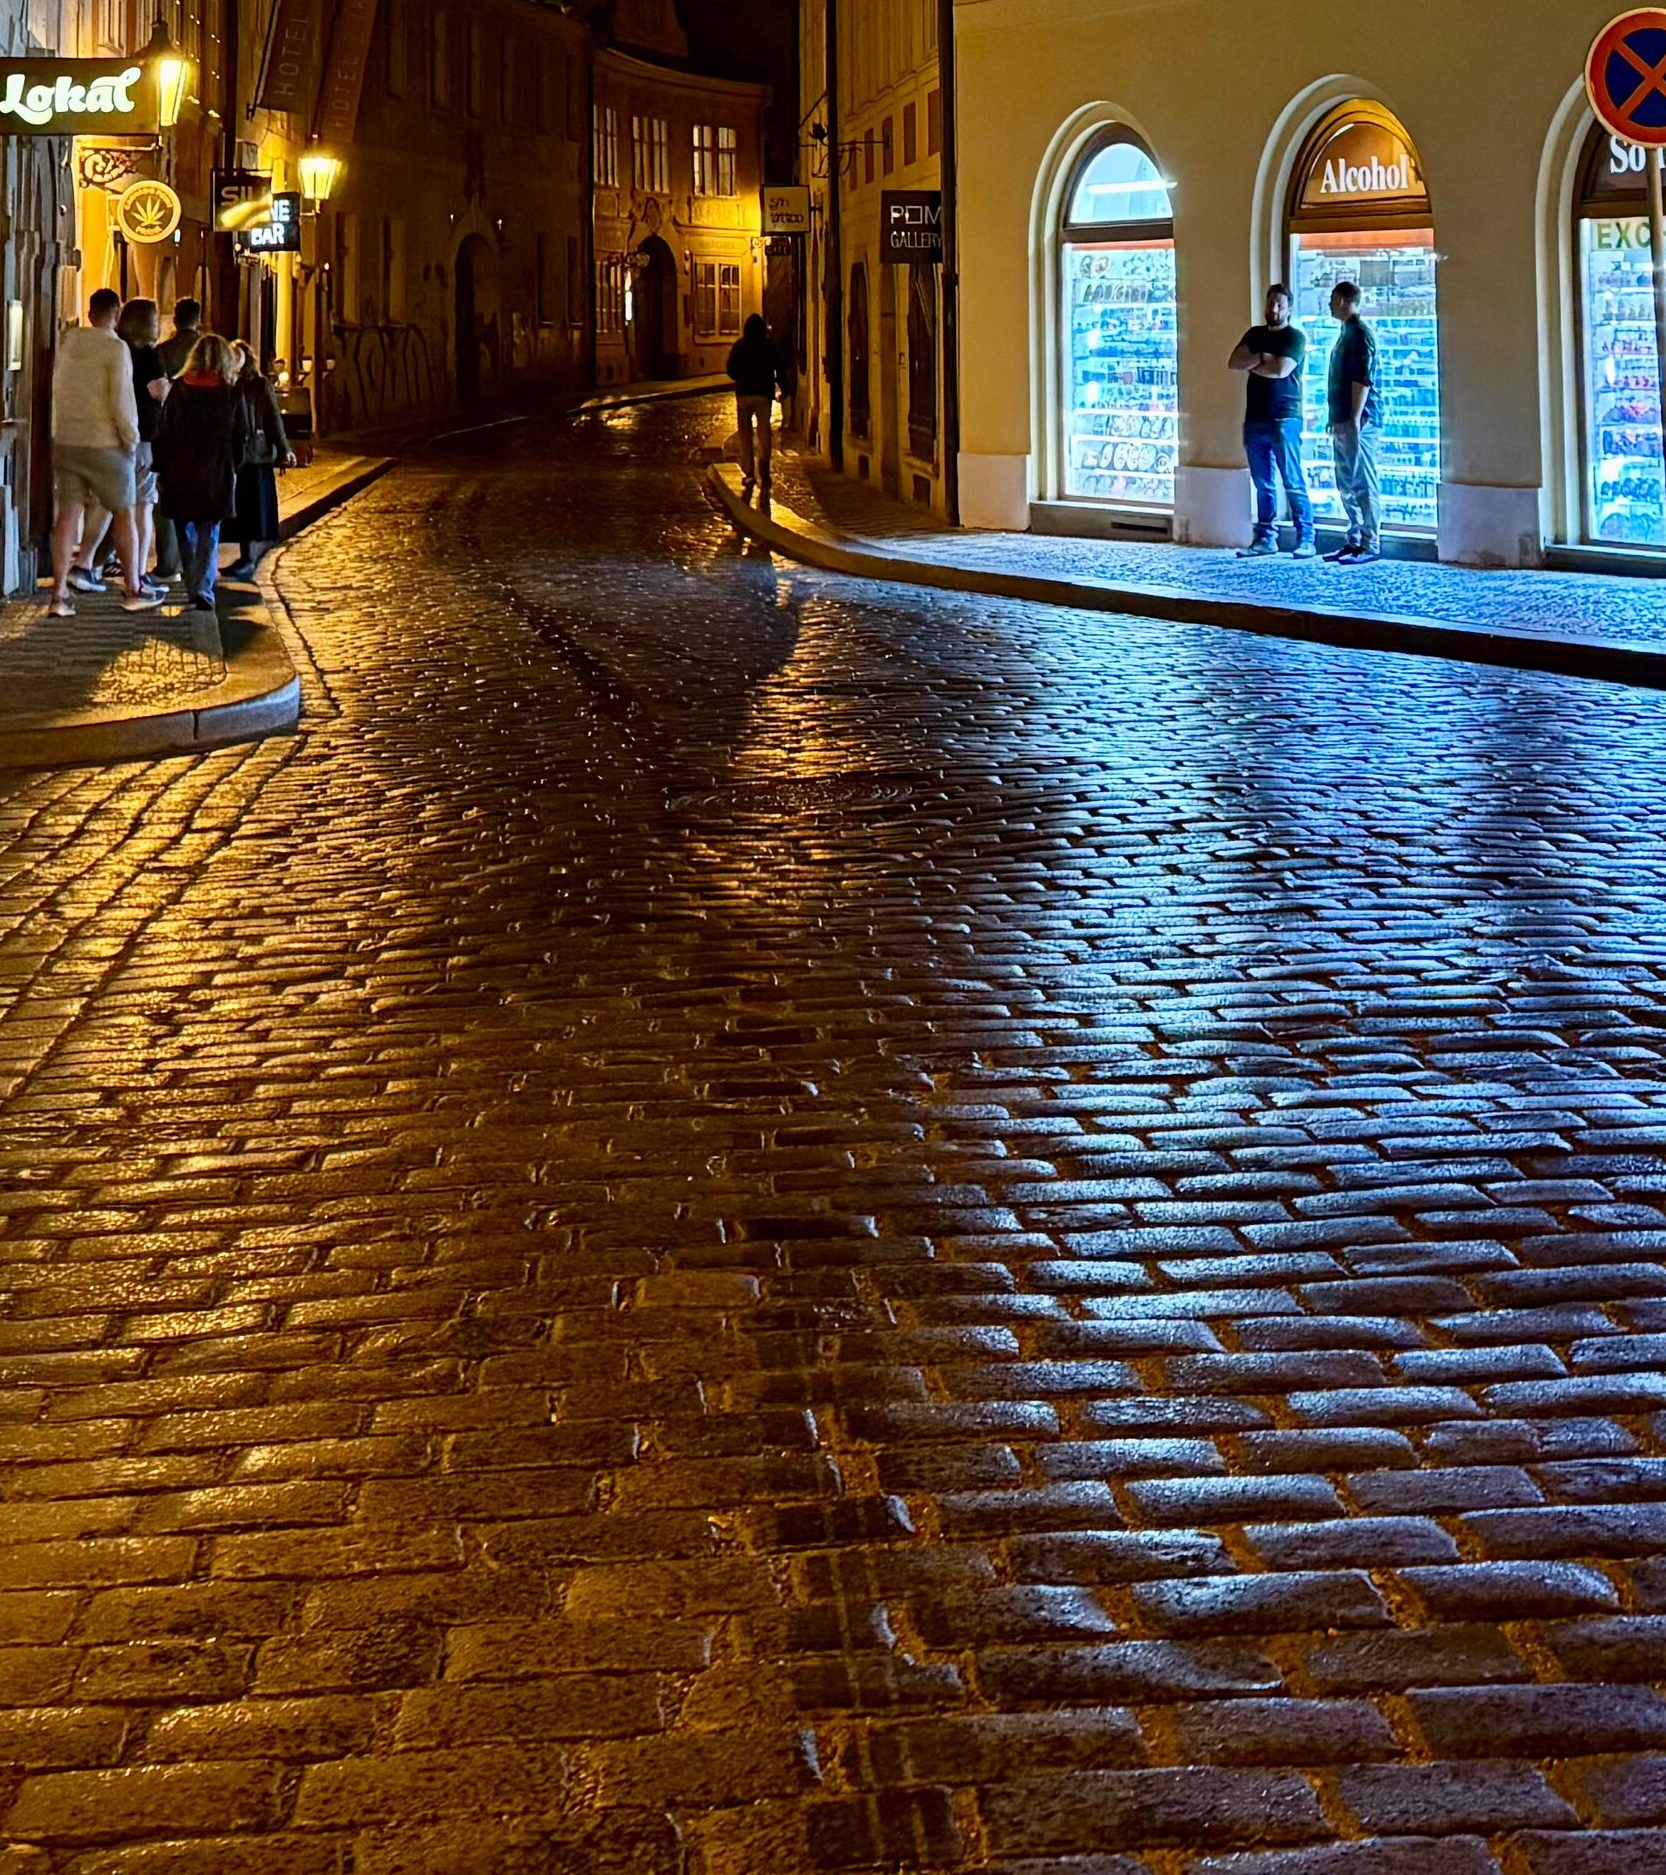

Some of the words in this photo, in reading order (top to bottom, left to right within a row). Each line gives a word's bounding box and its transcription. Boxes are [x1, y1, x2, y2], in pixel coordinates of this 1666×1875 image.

[274, 13, 310, 97] HOTEL
[1320, 153, 1409, 194] Alcohol
[251, 222, 285, 246] BAR
